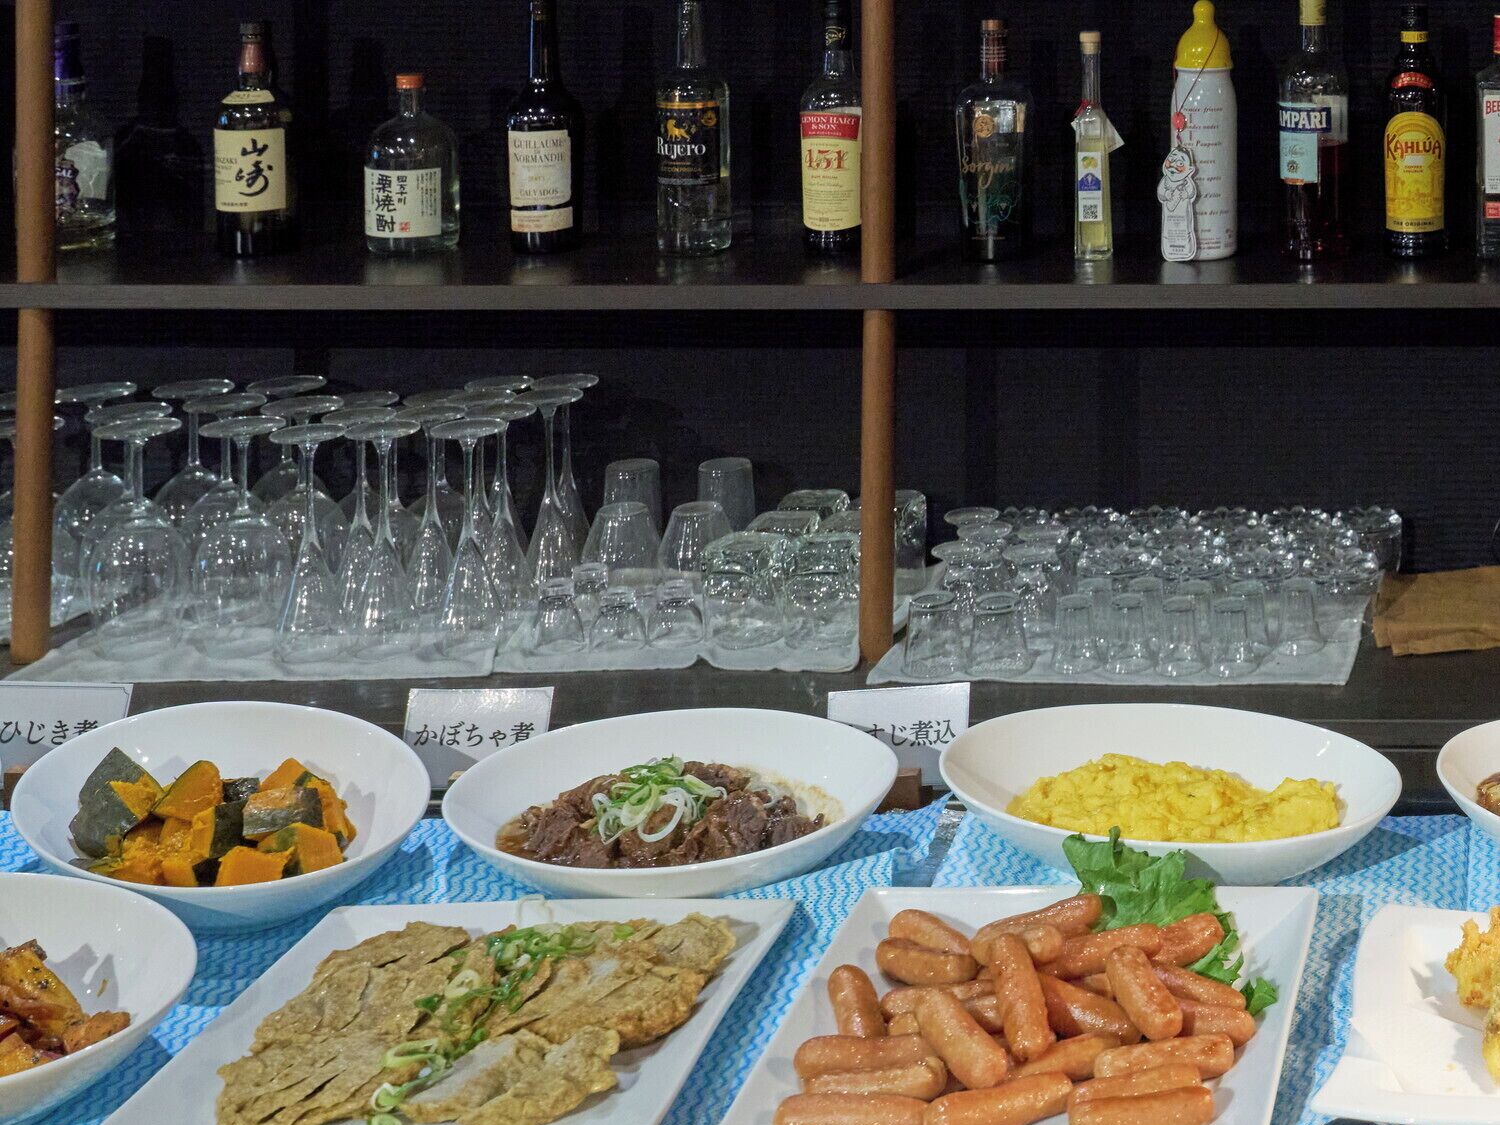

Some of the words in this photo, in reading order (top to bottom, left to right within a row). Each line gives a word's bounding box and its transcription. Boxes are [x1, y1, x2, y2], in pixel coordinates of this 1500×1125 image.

[829, 117, 857, 125] HART
[1386, 133, 1442, 160] KAHLÚA
[862, 720, 957, 747] すじ煮込
